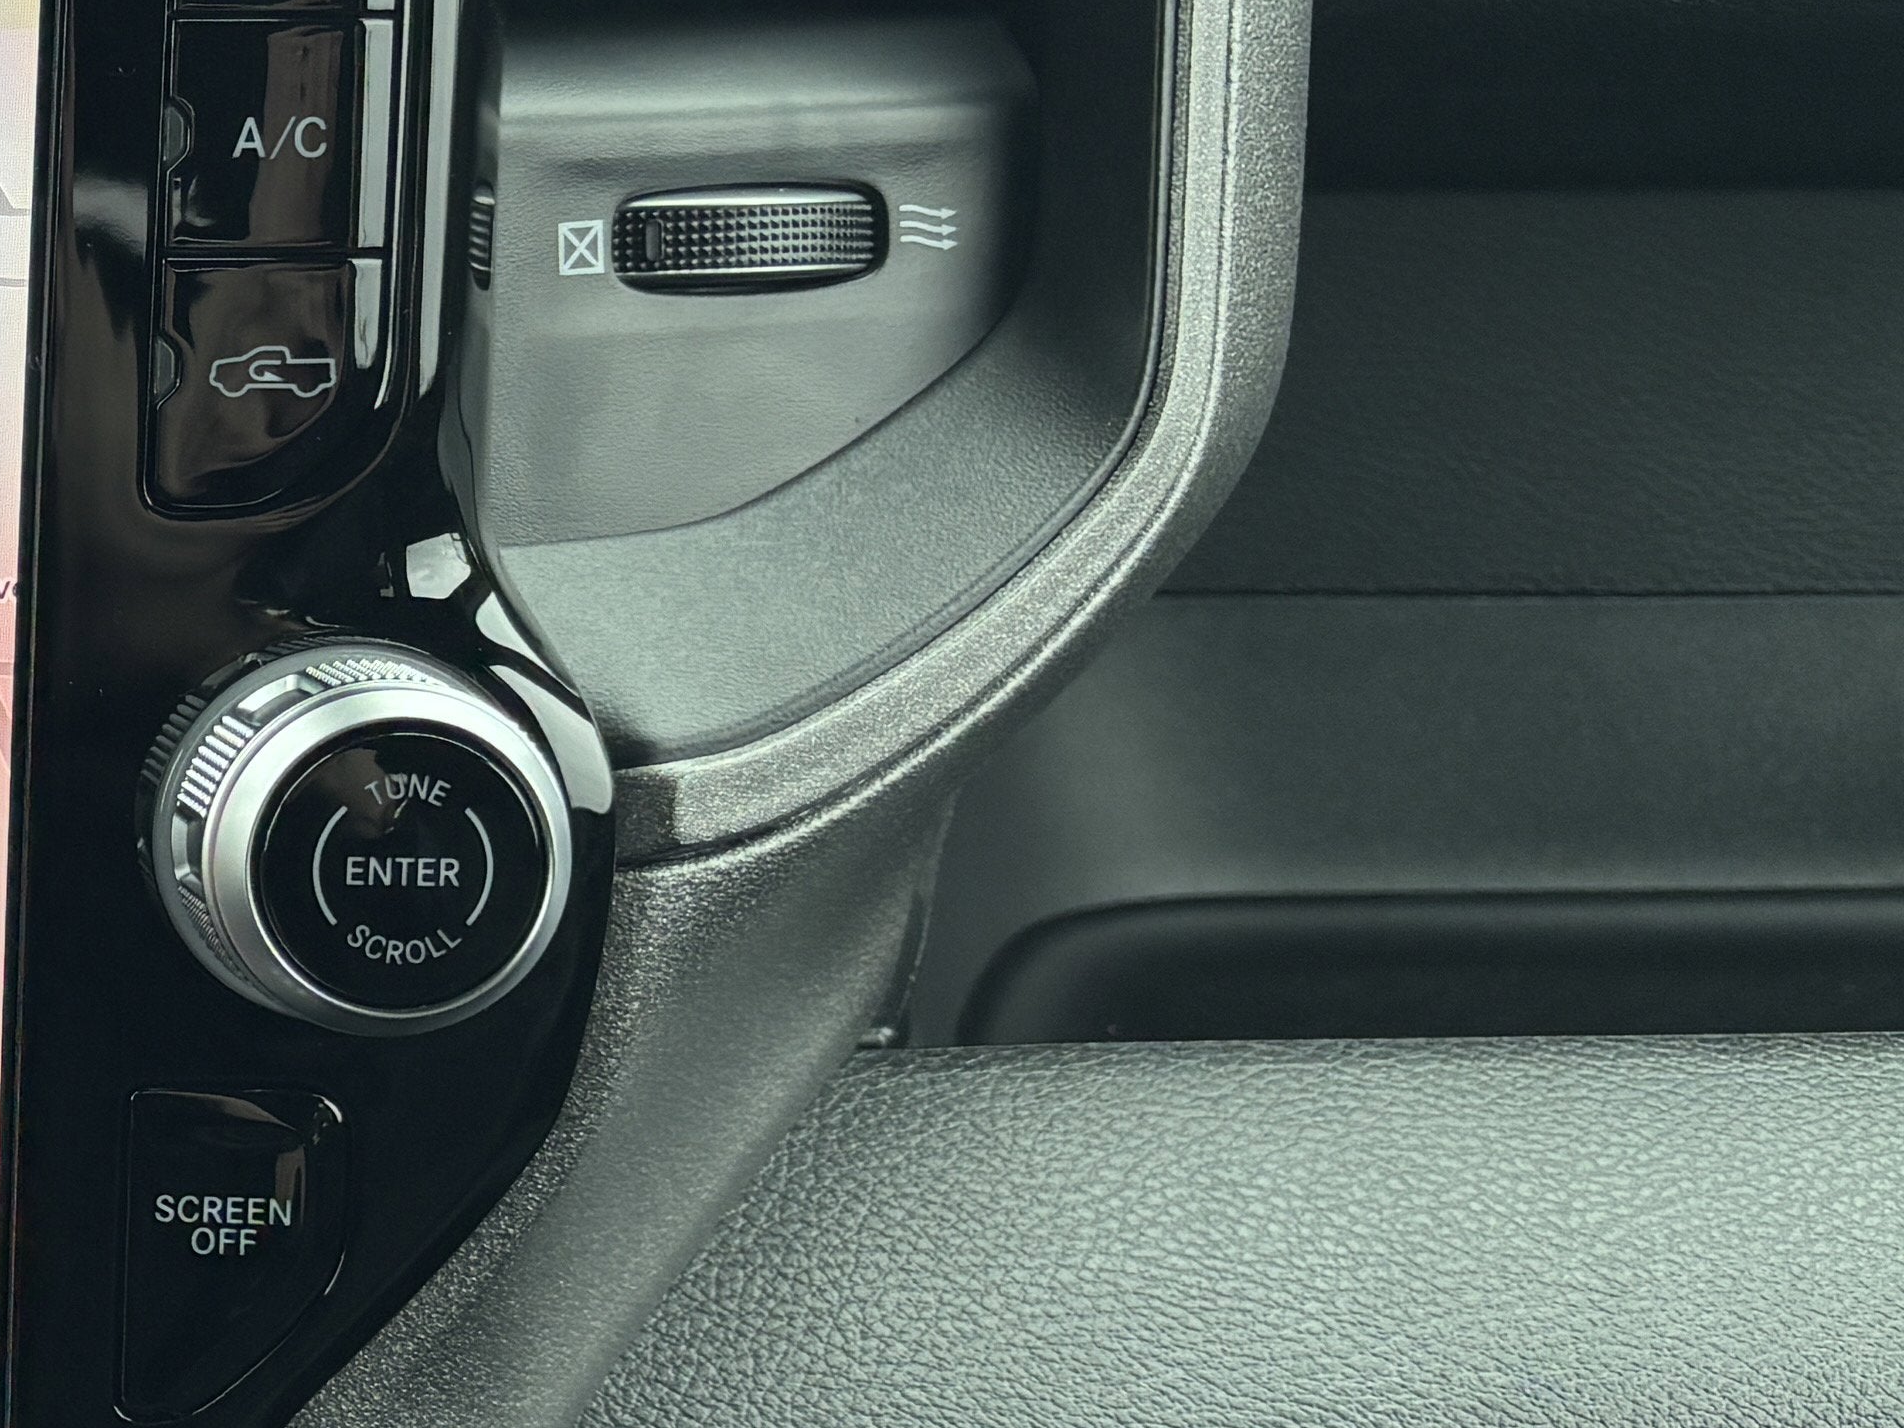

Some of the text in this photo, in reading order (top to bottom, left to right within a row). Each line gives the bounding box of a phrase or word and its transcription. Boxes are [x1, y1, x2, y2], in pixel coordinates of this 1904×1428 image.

[233, 118, 328, 160] A/C
[365, 773, 451, 807] TUNE
[346, 858, 460, 887] ENTER
[346, 924, 462, 965] SCROLL
[155, 1196, 292, 1226] SCREEN
[192, 1228, 257, 1256] OFF
